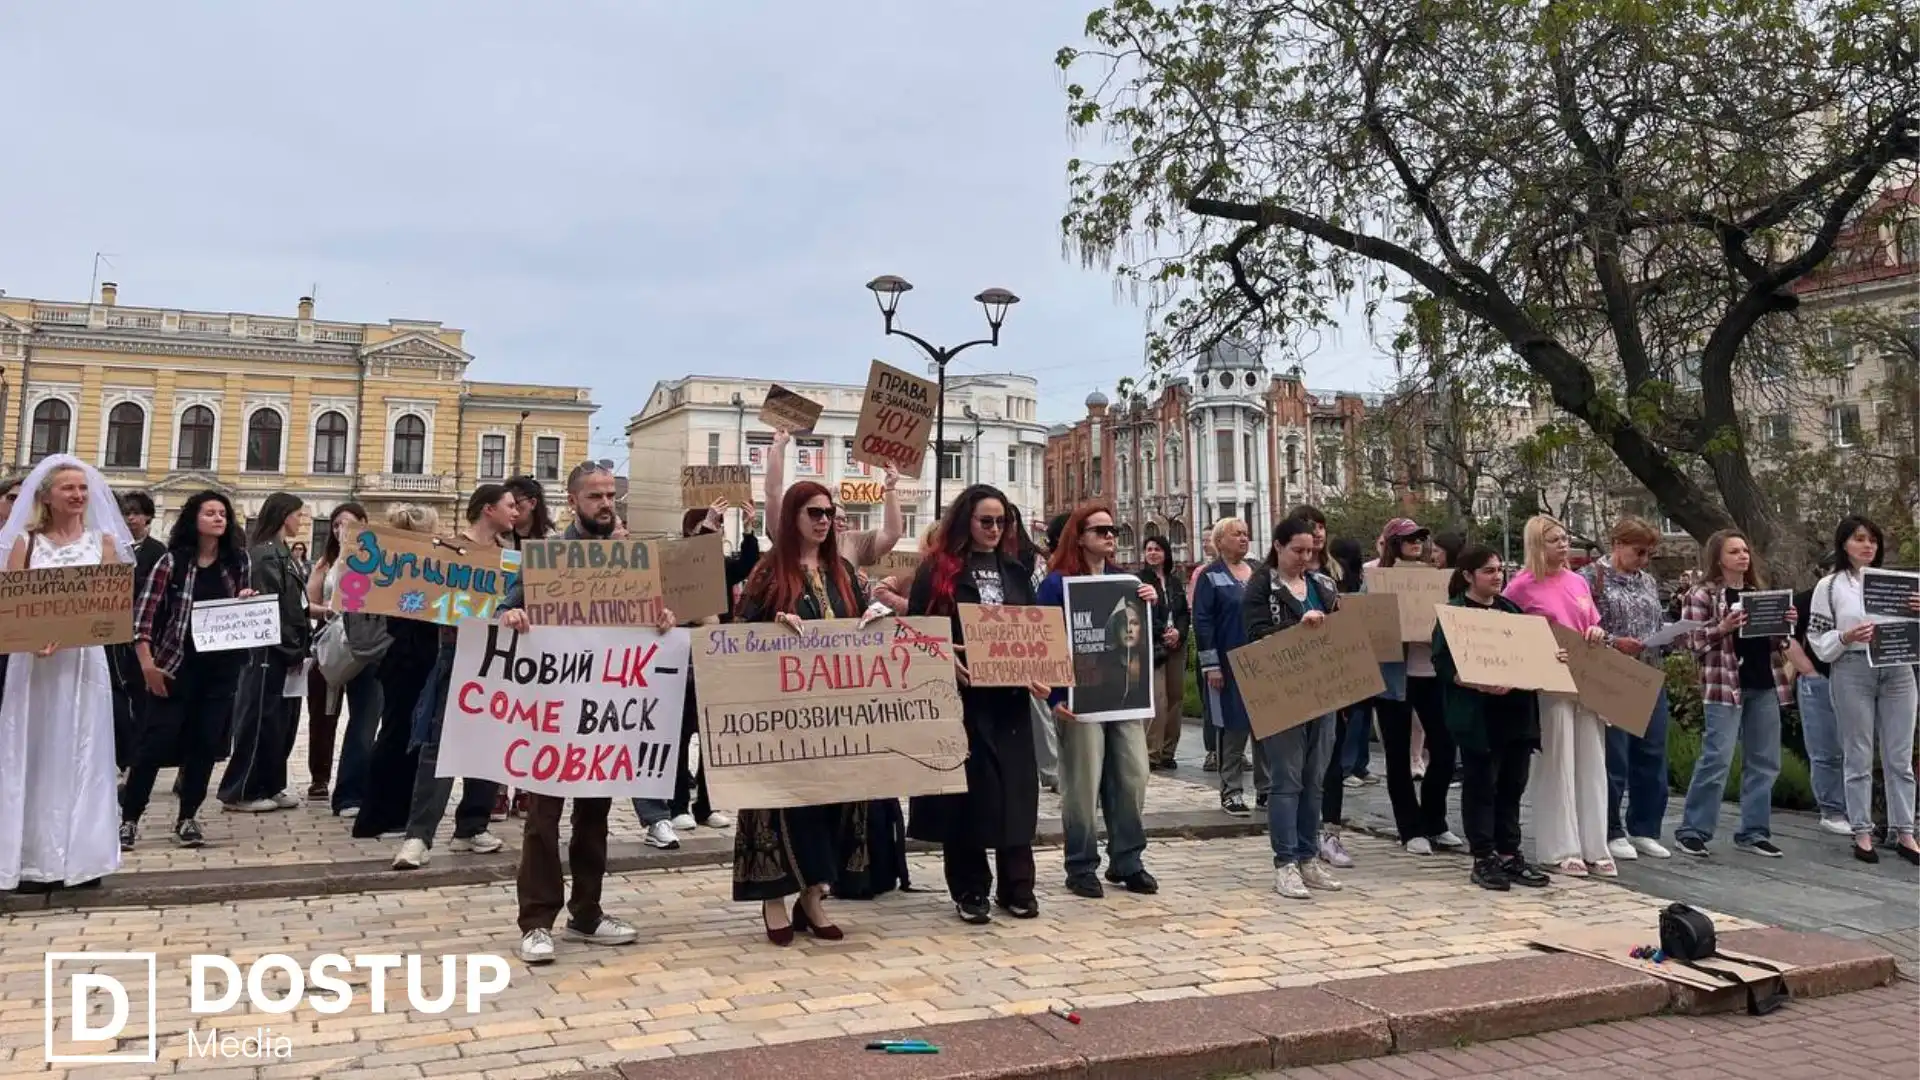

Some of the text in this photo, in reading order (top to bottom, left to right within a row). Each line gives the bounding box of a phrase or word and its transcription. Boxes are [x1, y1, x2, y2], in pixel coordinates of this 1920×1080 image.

[879, 371, 928, 403] ПРАВА
[876, 406, 920, 440] 404
[525, 541, 650, 569] ПРАВДА
[978, 605, 1044, 623] ХТО
[705, 630, 740, 655] Як
[745, 627, 885, 653] вимірювається
[988, 641, 1048, 660] МОЮ
[601, 643, 659, 688] ЦК
[779, 645, 912, 693] ВАША?
